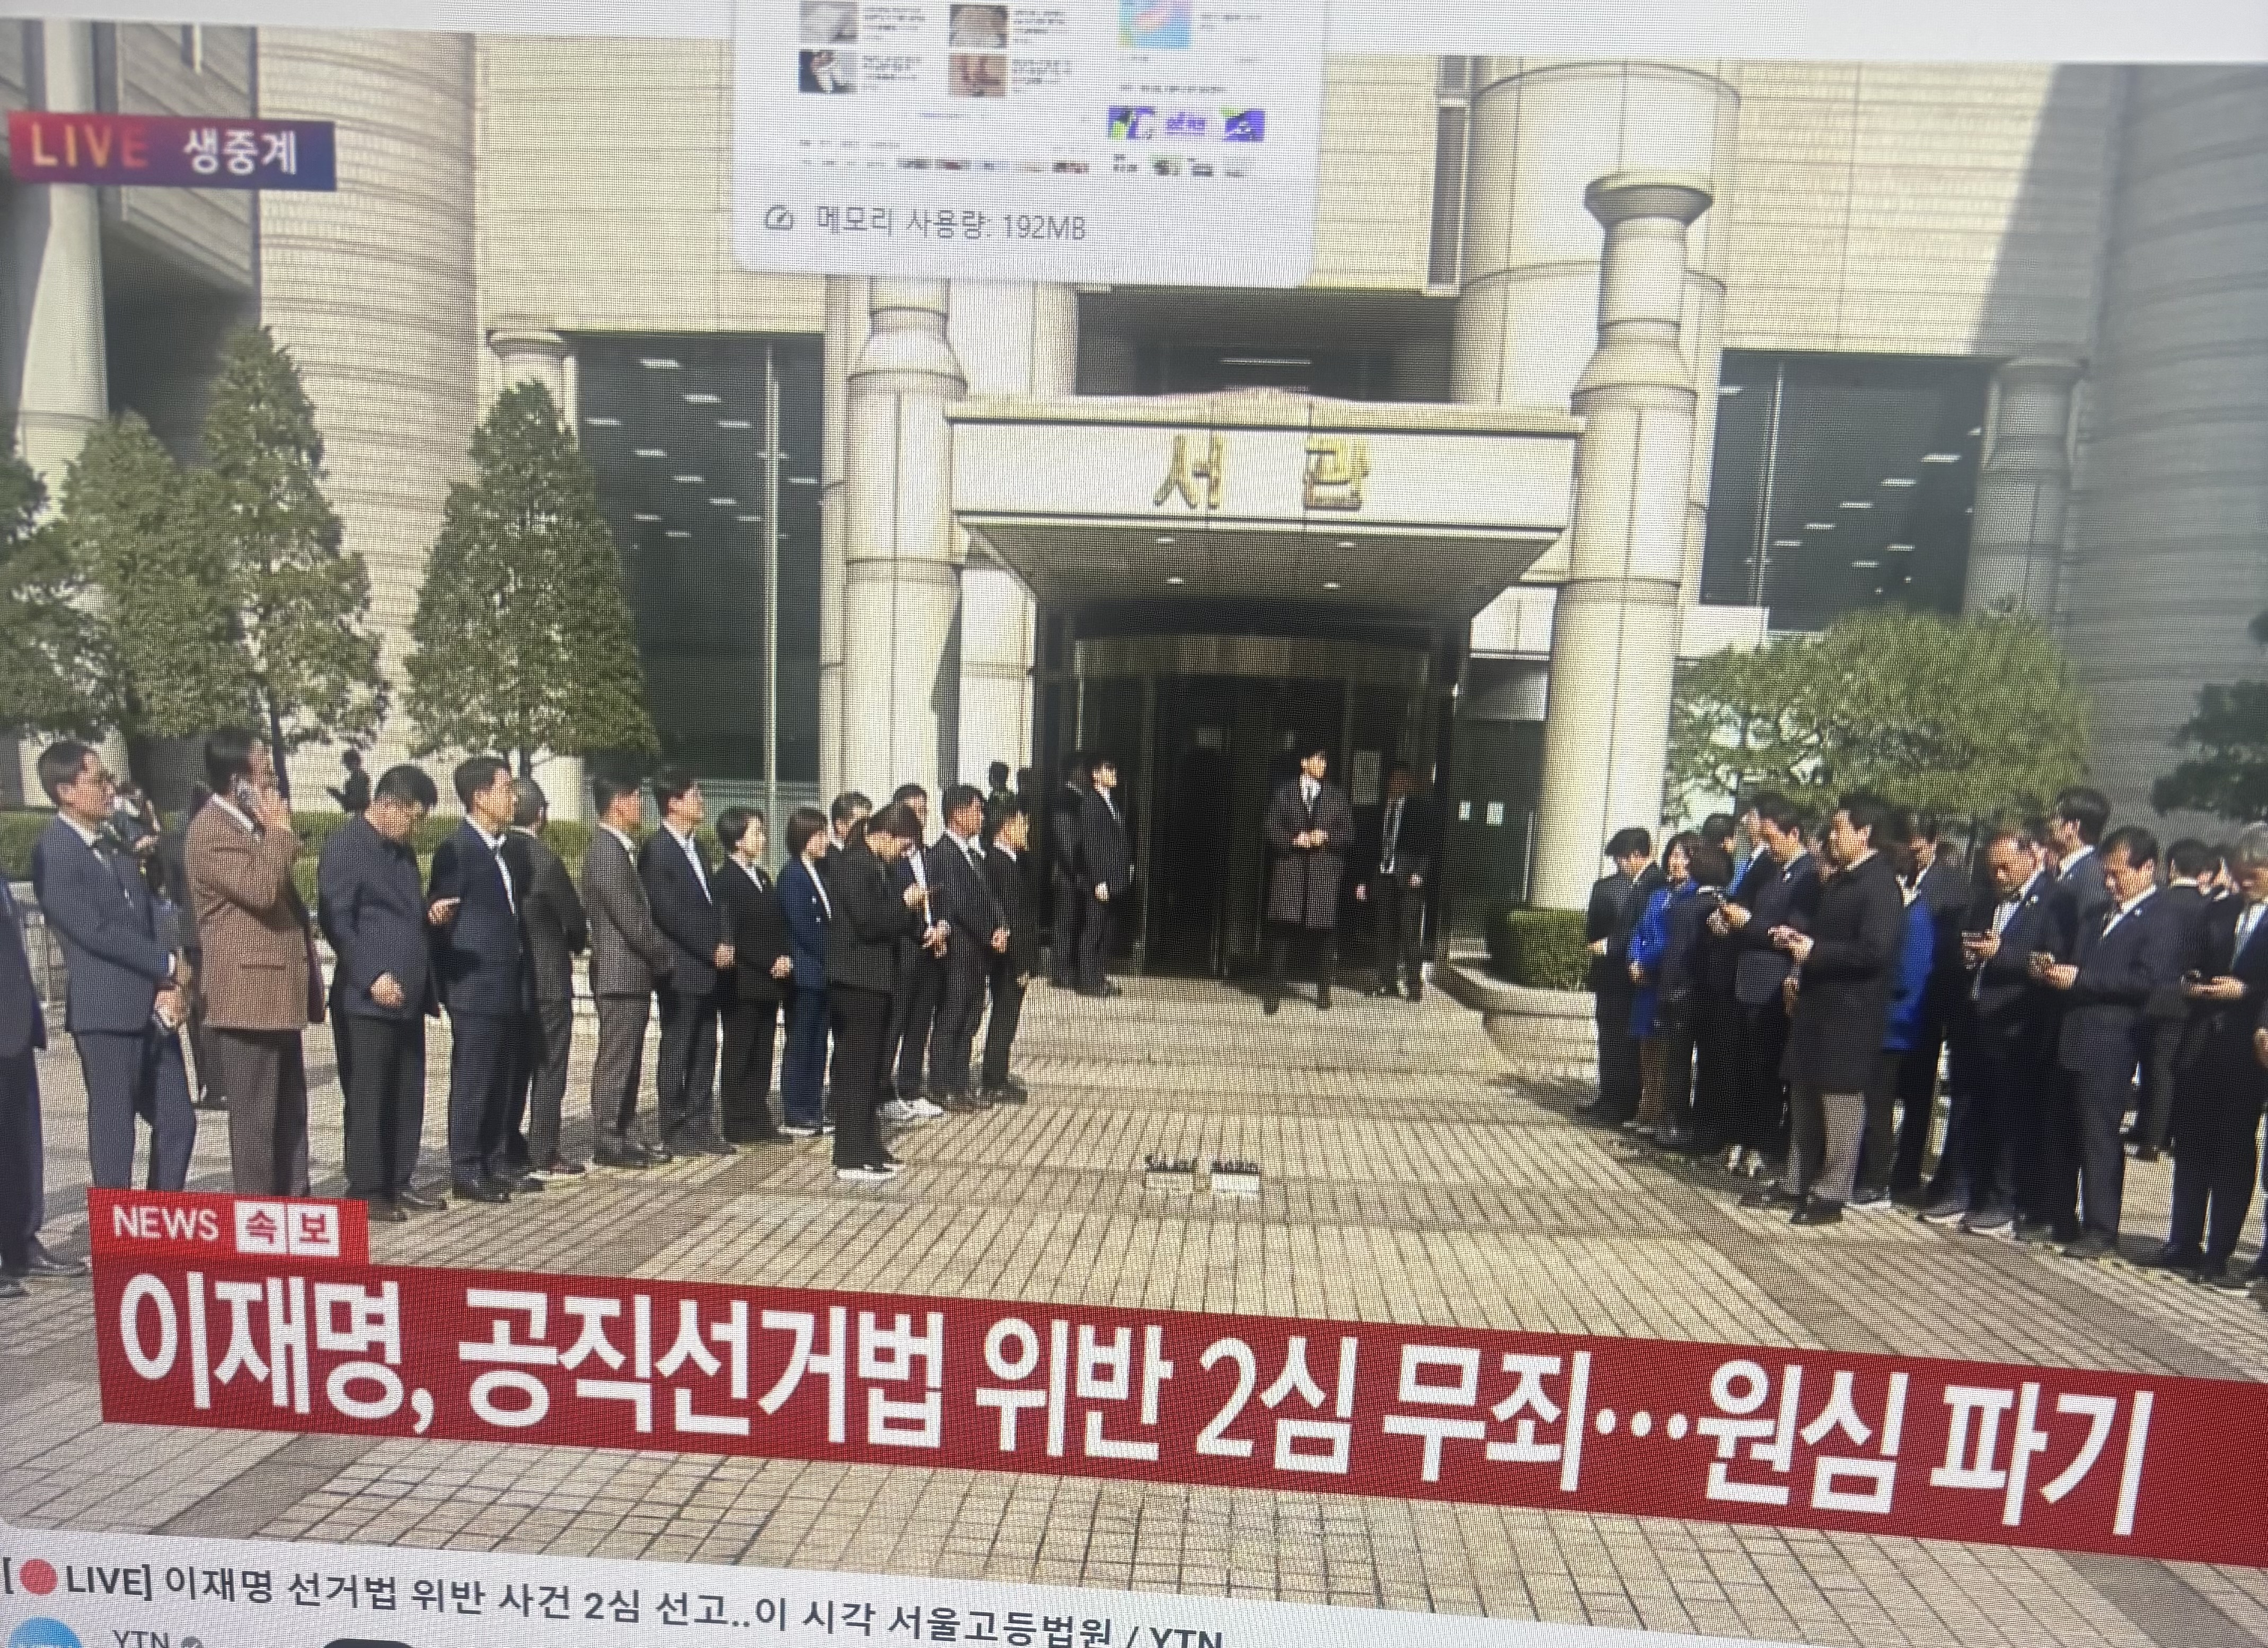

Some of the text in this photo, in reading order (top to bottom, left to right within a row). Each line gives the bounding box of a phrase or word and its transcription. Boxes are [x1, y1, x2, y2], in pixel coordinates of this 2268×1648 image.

[31, 121, 297, 175] LIVE 생중계
[817, 206, 1086, 241] 메모리 사용량: 192MB
[112, 1204, 333, 1246] NEWS 속보
[119, 1272, 435, 1434] 이재명,
[458, 1288, 944, 1449] 공직선거법
[976, 1317, 1174, 1461] 위반
[1196, 1336, 1358, 1475] 2심
[1929, 1381, 2155, 1536] 파기
[166, 1566, 273, 1605] 이재명
[288, 1572, 397, 1611] 선거법
[412, 1578, 486, 1616] 위반
[498, 1582, 570, 1619] 사건
[584, 1589, 639, 1624] 2심
[802, 1599, 877, 1637] 시각
[888, 1605, 1111, 1648] 서울고등법원
[1148, 1626, 1222, 1648] YTN
[112, 1629, 170, 1648] YTN
